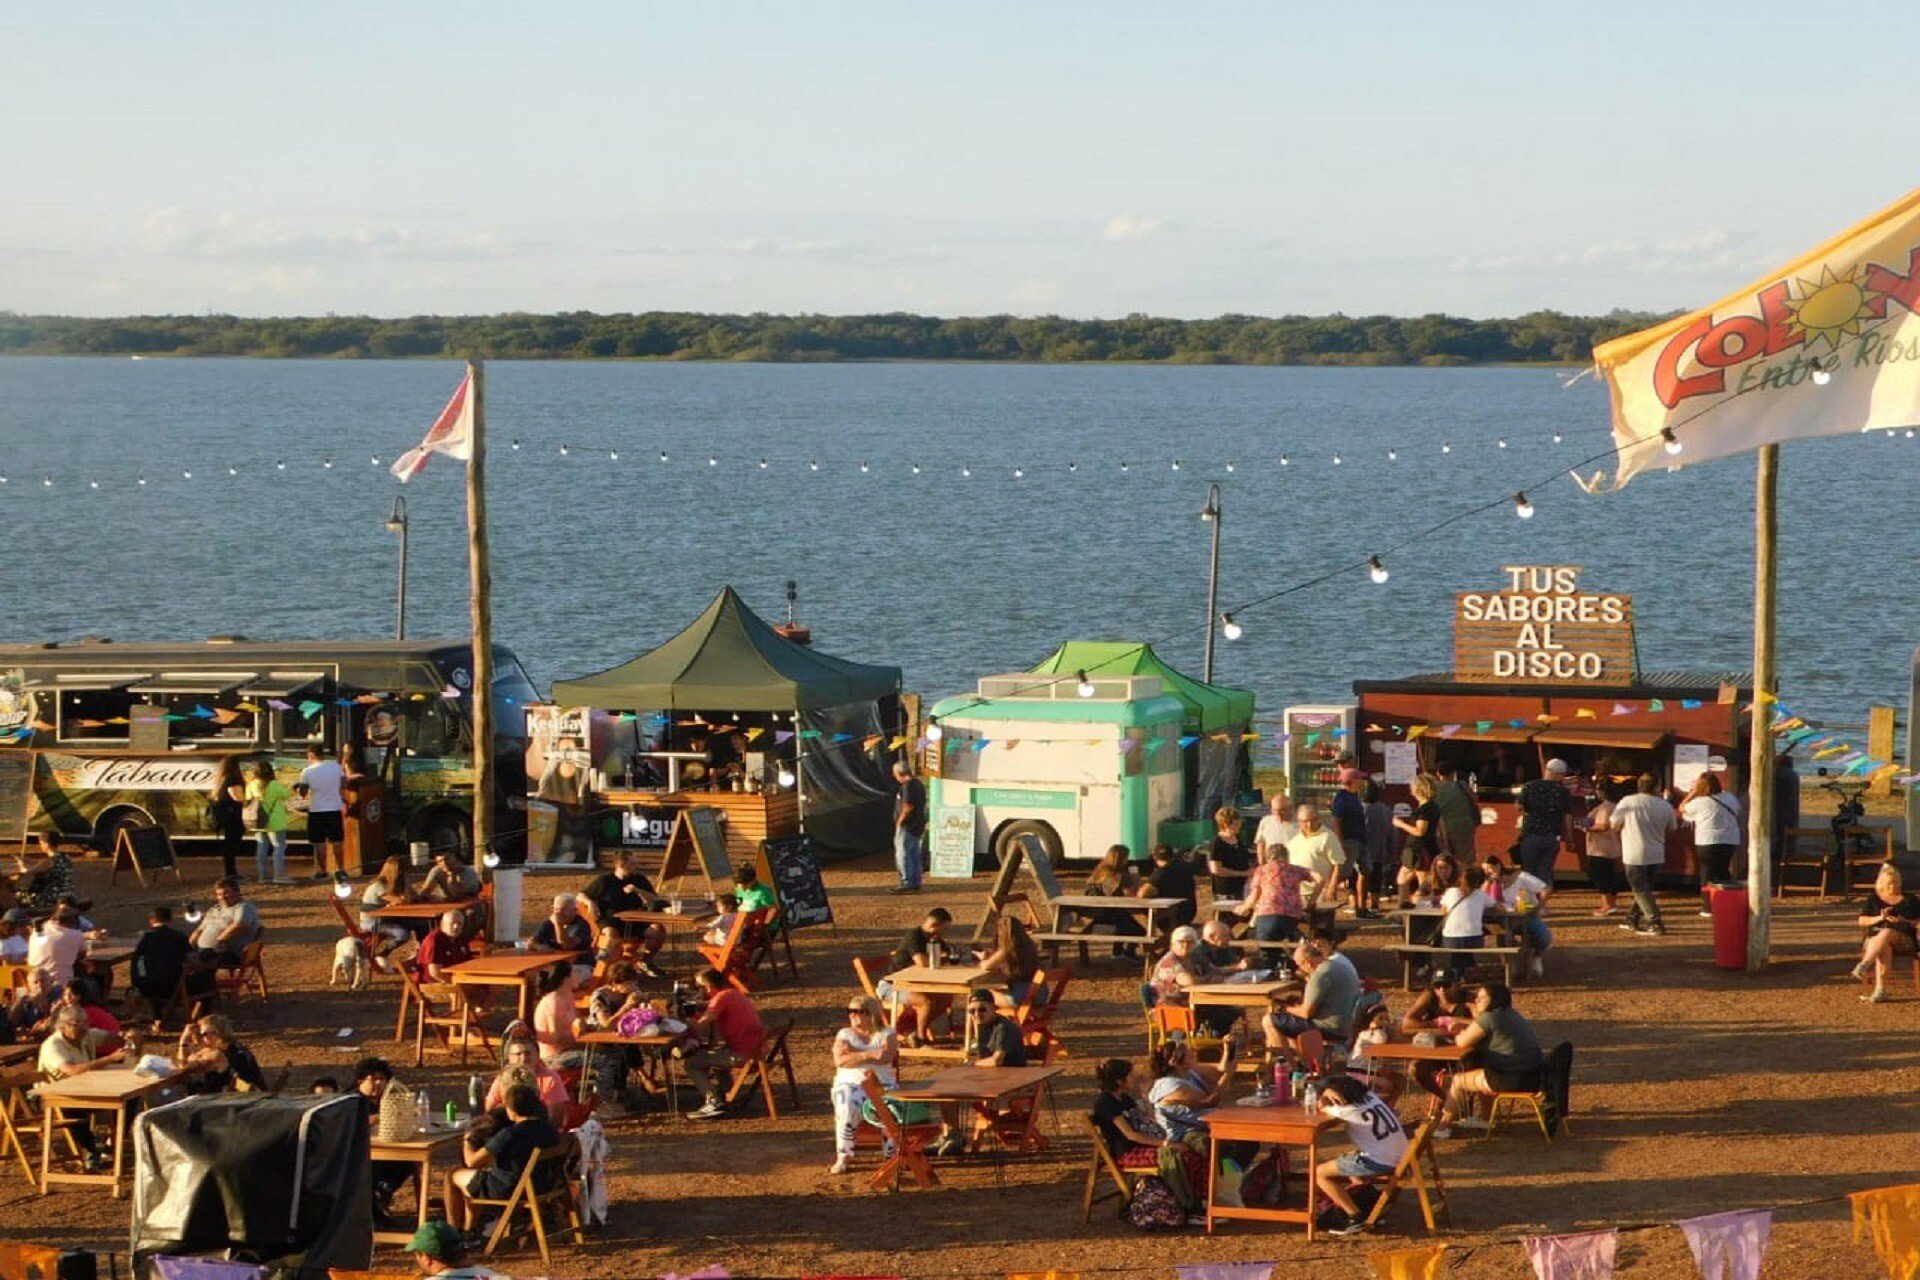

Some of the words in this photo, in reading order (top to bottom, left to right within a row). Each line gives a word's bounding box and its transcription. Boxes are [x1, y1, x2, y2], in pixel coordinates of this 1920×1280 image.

[1505, 566, 1577, 595] TUS
[1462, 594, 1624, 624] SABORES
[1515, 623, 1564, 650] AL
[1493, 650, 1602, 679] DISCO
[1361, 1104, 1400, 1141] 20
